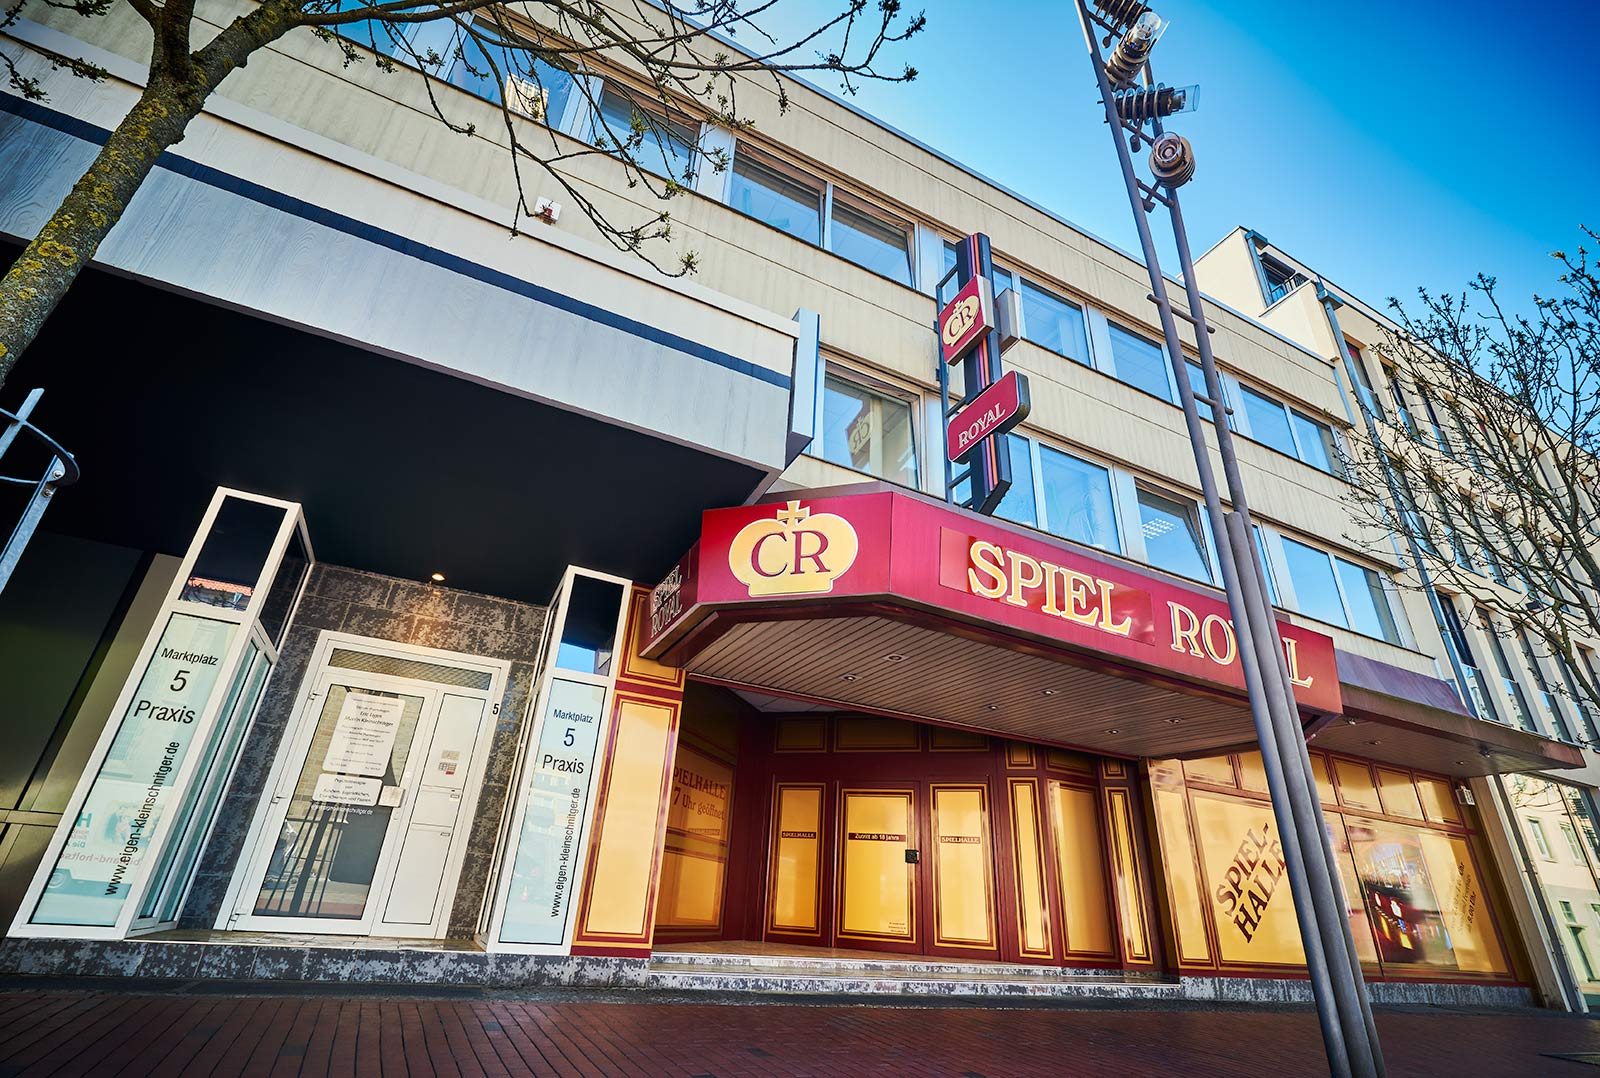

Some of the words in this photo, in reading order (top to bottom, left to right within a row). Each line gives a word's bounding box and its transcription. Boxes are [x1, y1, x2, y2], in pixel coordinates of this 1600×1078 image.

[948, 305, 973, 337] CR
[958, 402, 1006, 449] ROYAL
[750, 529, 831, 575] CR
[651, 590, 683, 639] ROYAL
[966, 540, 1132, 636] SPIEL
[1167, 600, 1313, 688] ROL
[161, 647, 218, 667] Marktplatz
[169, 670, 190, 692] 5
[133, 700, 196, 724] Praxis
[492, 703, 500, 715] 5
[553, 708, 593, 725] Marktplatz
[563, 728, 575, 748] 5
[542, 754, 584, 775] Praxis
[673, 766, 726, 800] PIELHALLE
[683, 793, 697, 809] Uhr
[104, 741, 181, 896] www.eigen-kleinschnitger.de
[782, 831, 815, 839] SPIELHALLE
[941, 836, 980, 844] SPIELHALLE
[550, 786, 581, 918] www.eigen-kleinschnitger.de
[1216, 822, 1269, 917] SPIEL-
[1233, 839, 1286, 943] HALLE
